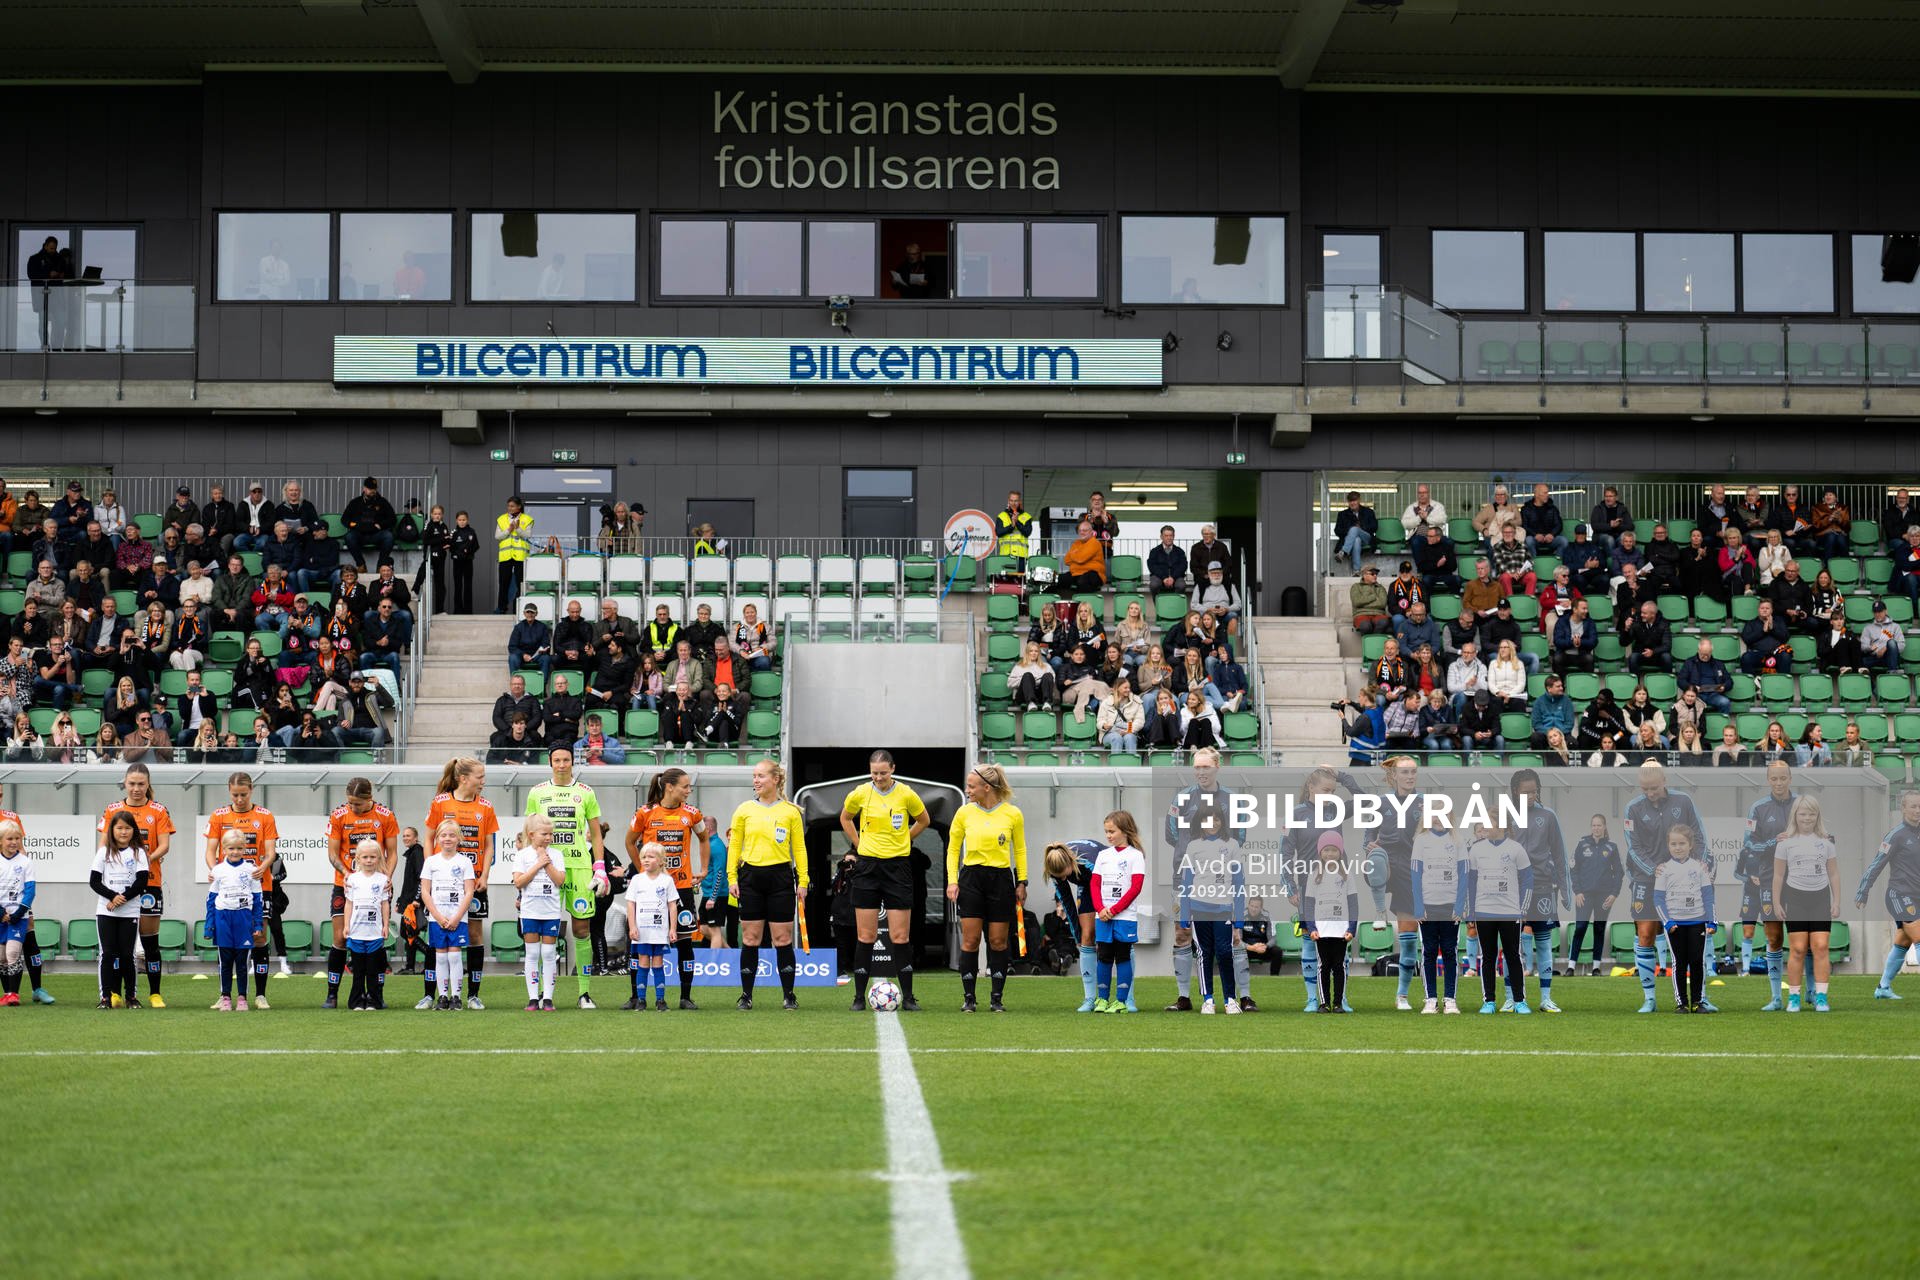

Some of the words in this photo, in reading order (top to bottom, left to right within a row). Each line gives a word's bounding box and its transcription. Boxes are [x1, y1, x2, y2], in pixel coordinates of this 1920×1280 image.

[713, 90, 1058, 136] Kristianstads
[713, 145, 1061, 190] fotbollsarena
[23, 835, 80, 848] tianstads
[28, 851, 54, 860] mun
[279, 852, 305, 861] mun
[677, 963, 731, 977] BOS
[778, 963, 830, 977] BOS
